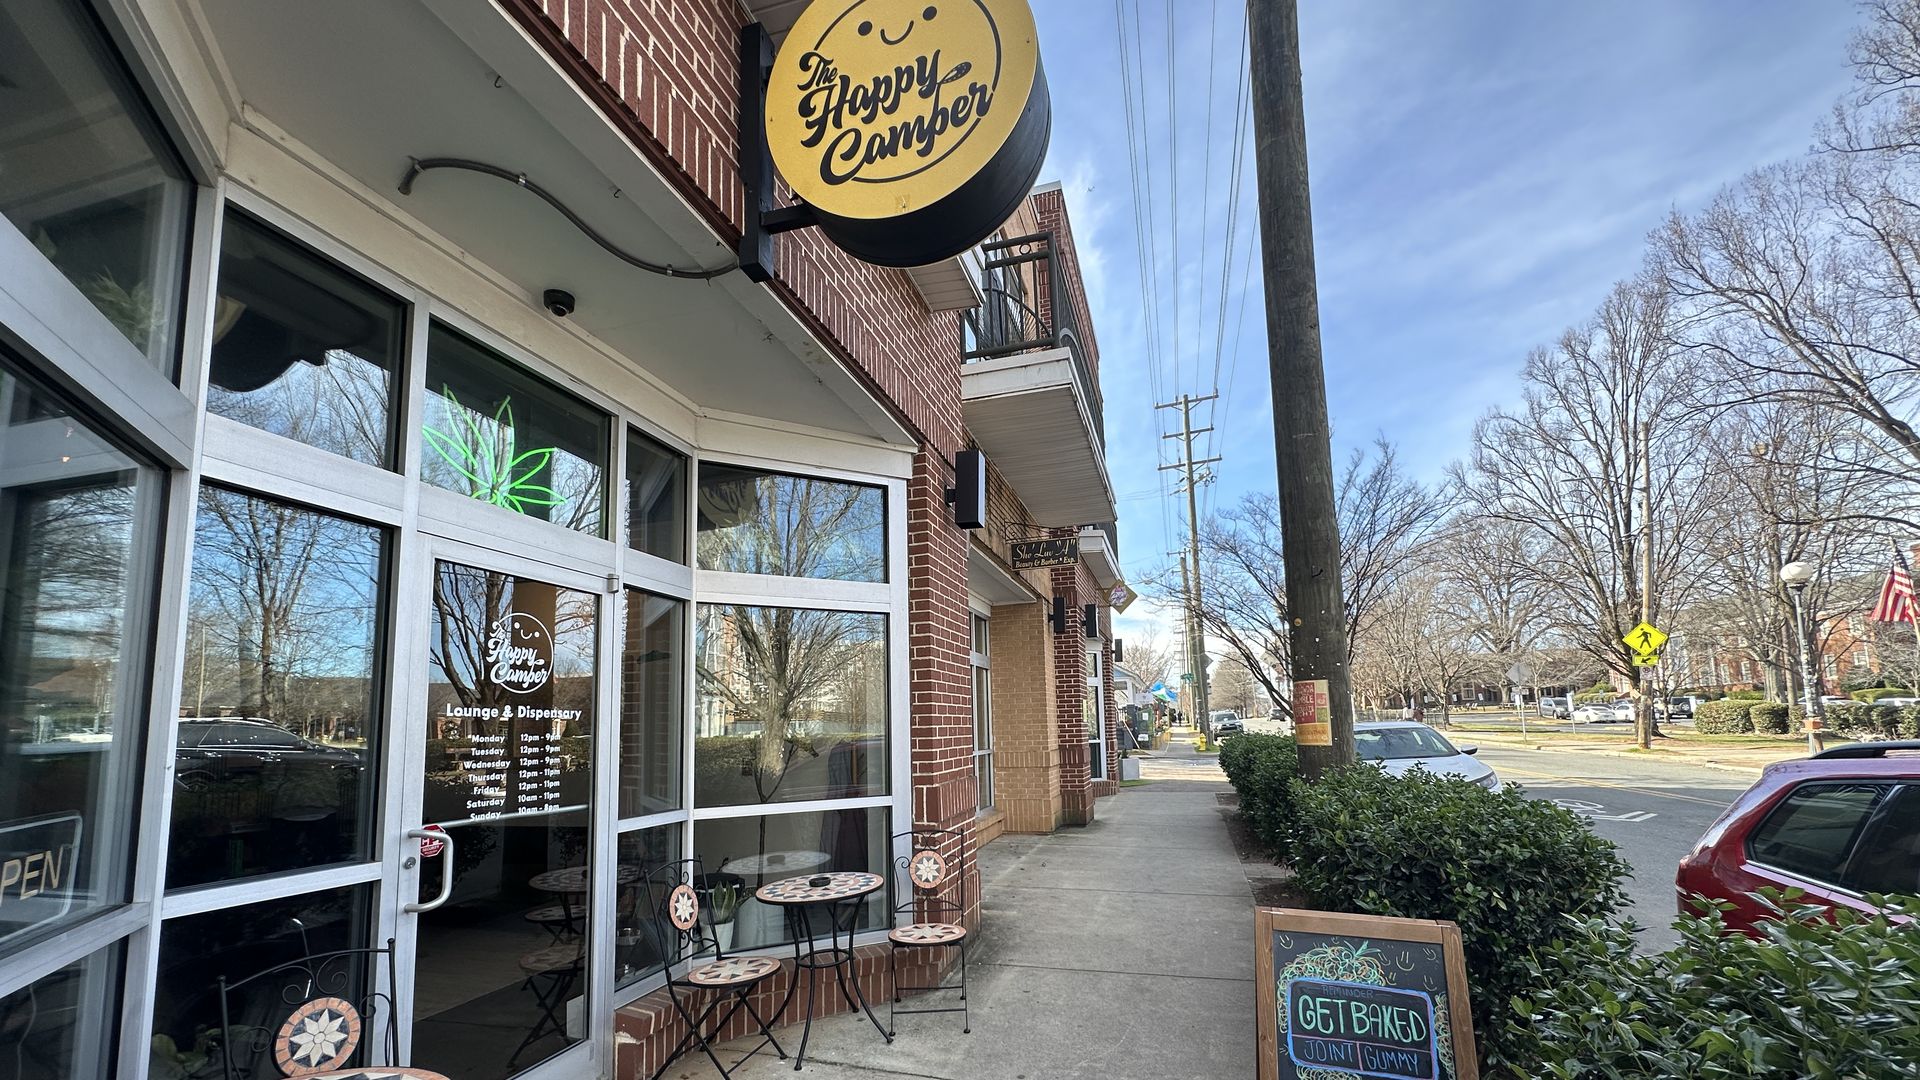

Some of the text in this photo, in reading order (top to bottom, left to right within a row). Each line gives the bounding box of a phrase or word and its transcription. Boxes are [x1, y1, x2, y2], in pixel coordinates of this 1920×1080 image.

[797, 51, 839, 91] The
[798, 49, 941, 148] Happy
[819, 81, 993, 185] Camper
[1034, 559, 1040, 567] &
[1040, 558, 1058, 566] Barber
[486, 638, 538, 667] Happy
[490, 661, 548, 689] Camper
[446, 703, 583, 721] Lounge & Dispensary
[471, 734, 505, 743] Monday
[520, 733, 539, 742] 12pm
[545, 733, 561, 742] 9pm
[471, 747, 505, 756] Tuesday
[520, 746, 539, 754] 12pm
[545, 745, 560, 753] 9pm
[463, 760, 511, 769] Wednesday
[519, 758, 539, 766] 12pm
[544, 756, 560, 765] 9pm
[468, 773, 506, 782] Thursday
[519, 770, 538, 779] 12pm
[544, 768, 560, 777] 11pm
[473, 786, 500, 795] Friday
[518, 782, 538, 791] 12pm
[544, 780, 560, 789] 11pm
[466, 798, 505, 809] Saturday
[518, 794, 538, 803] 10am
[544, 791, 560, 800] 11pm
[470, 811, 501, 821] Sunday
[518, 806, 538, 815] 10am
[544, 803, 560, 812] 8pm
[1299, 995, 1427, 1043] GET BAKED
[1304, 1040, 1419, 1076] JOINT GUMMY
